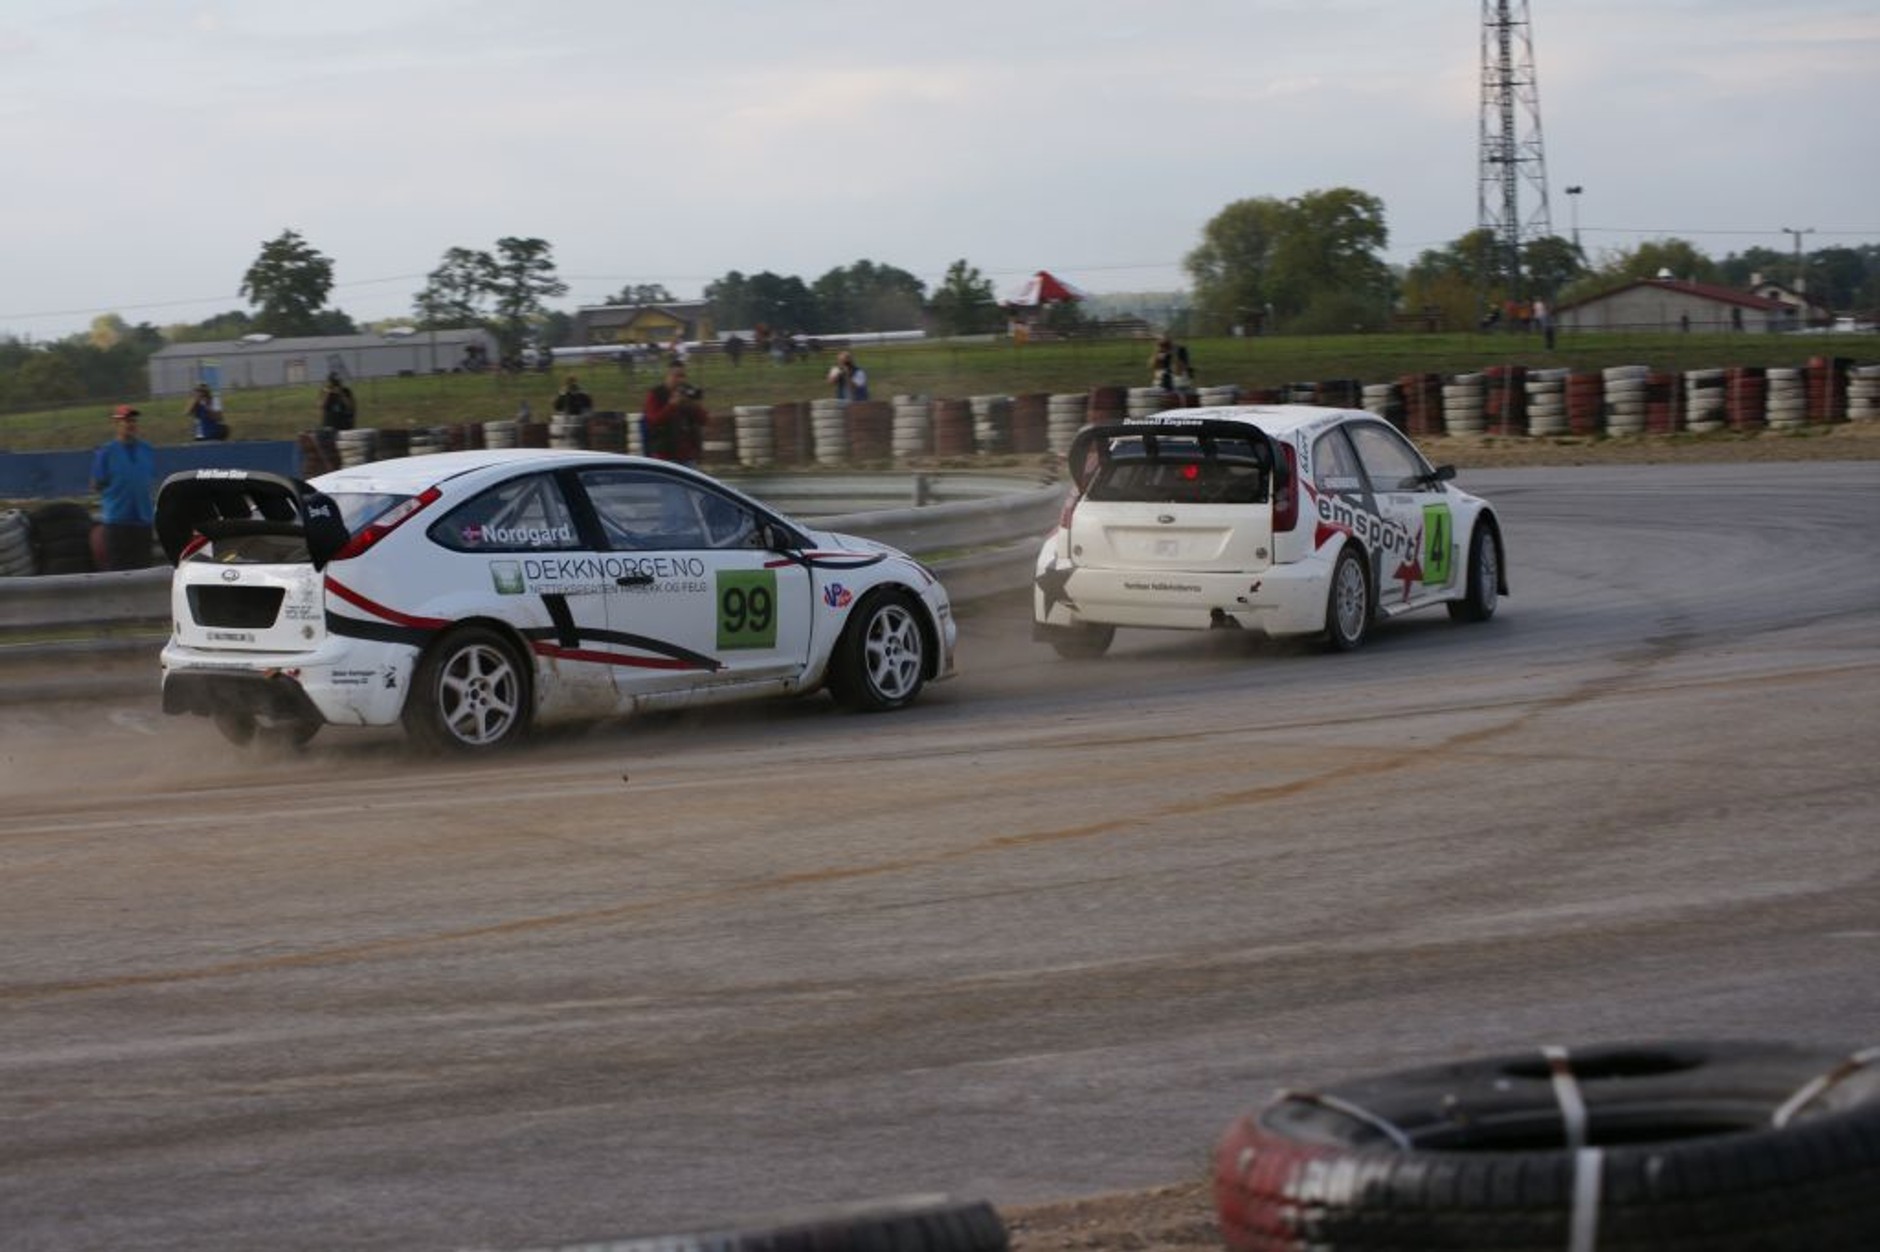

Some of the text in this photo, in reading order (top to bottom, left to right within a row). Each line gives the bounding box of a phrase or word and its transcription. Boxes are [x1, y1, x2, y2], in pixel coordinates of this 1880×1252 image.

[480, 522, 571, 547] Nordgard
[1317, 498, 1416, 563] emsport
[1430, 513, 1444, 573] 4
[722, 585, 772, 633] 99
